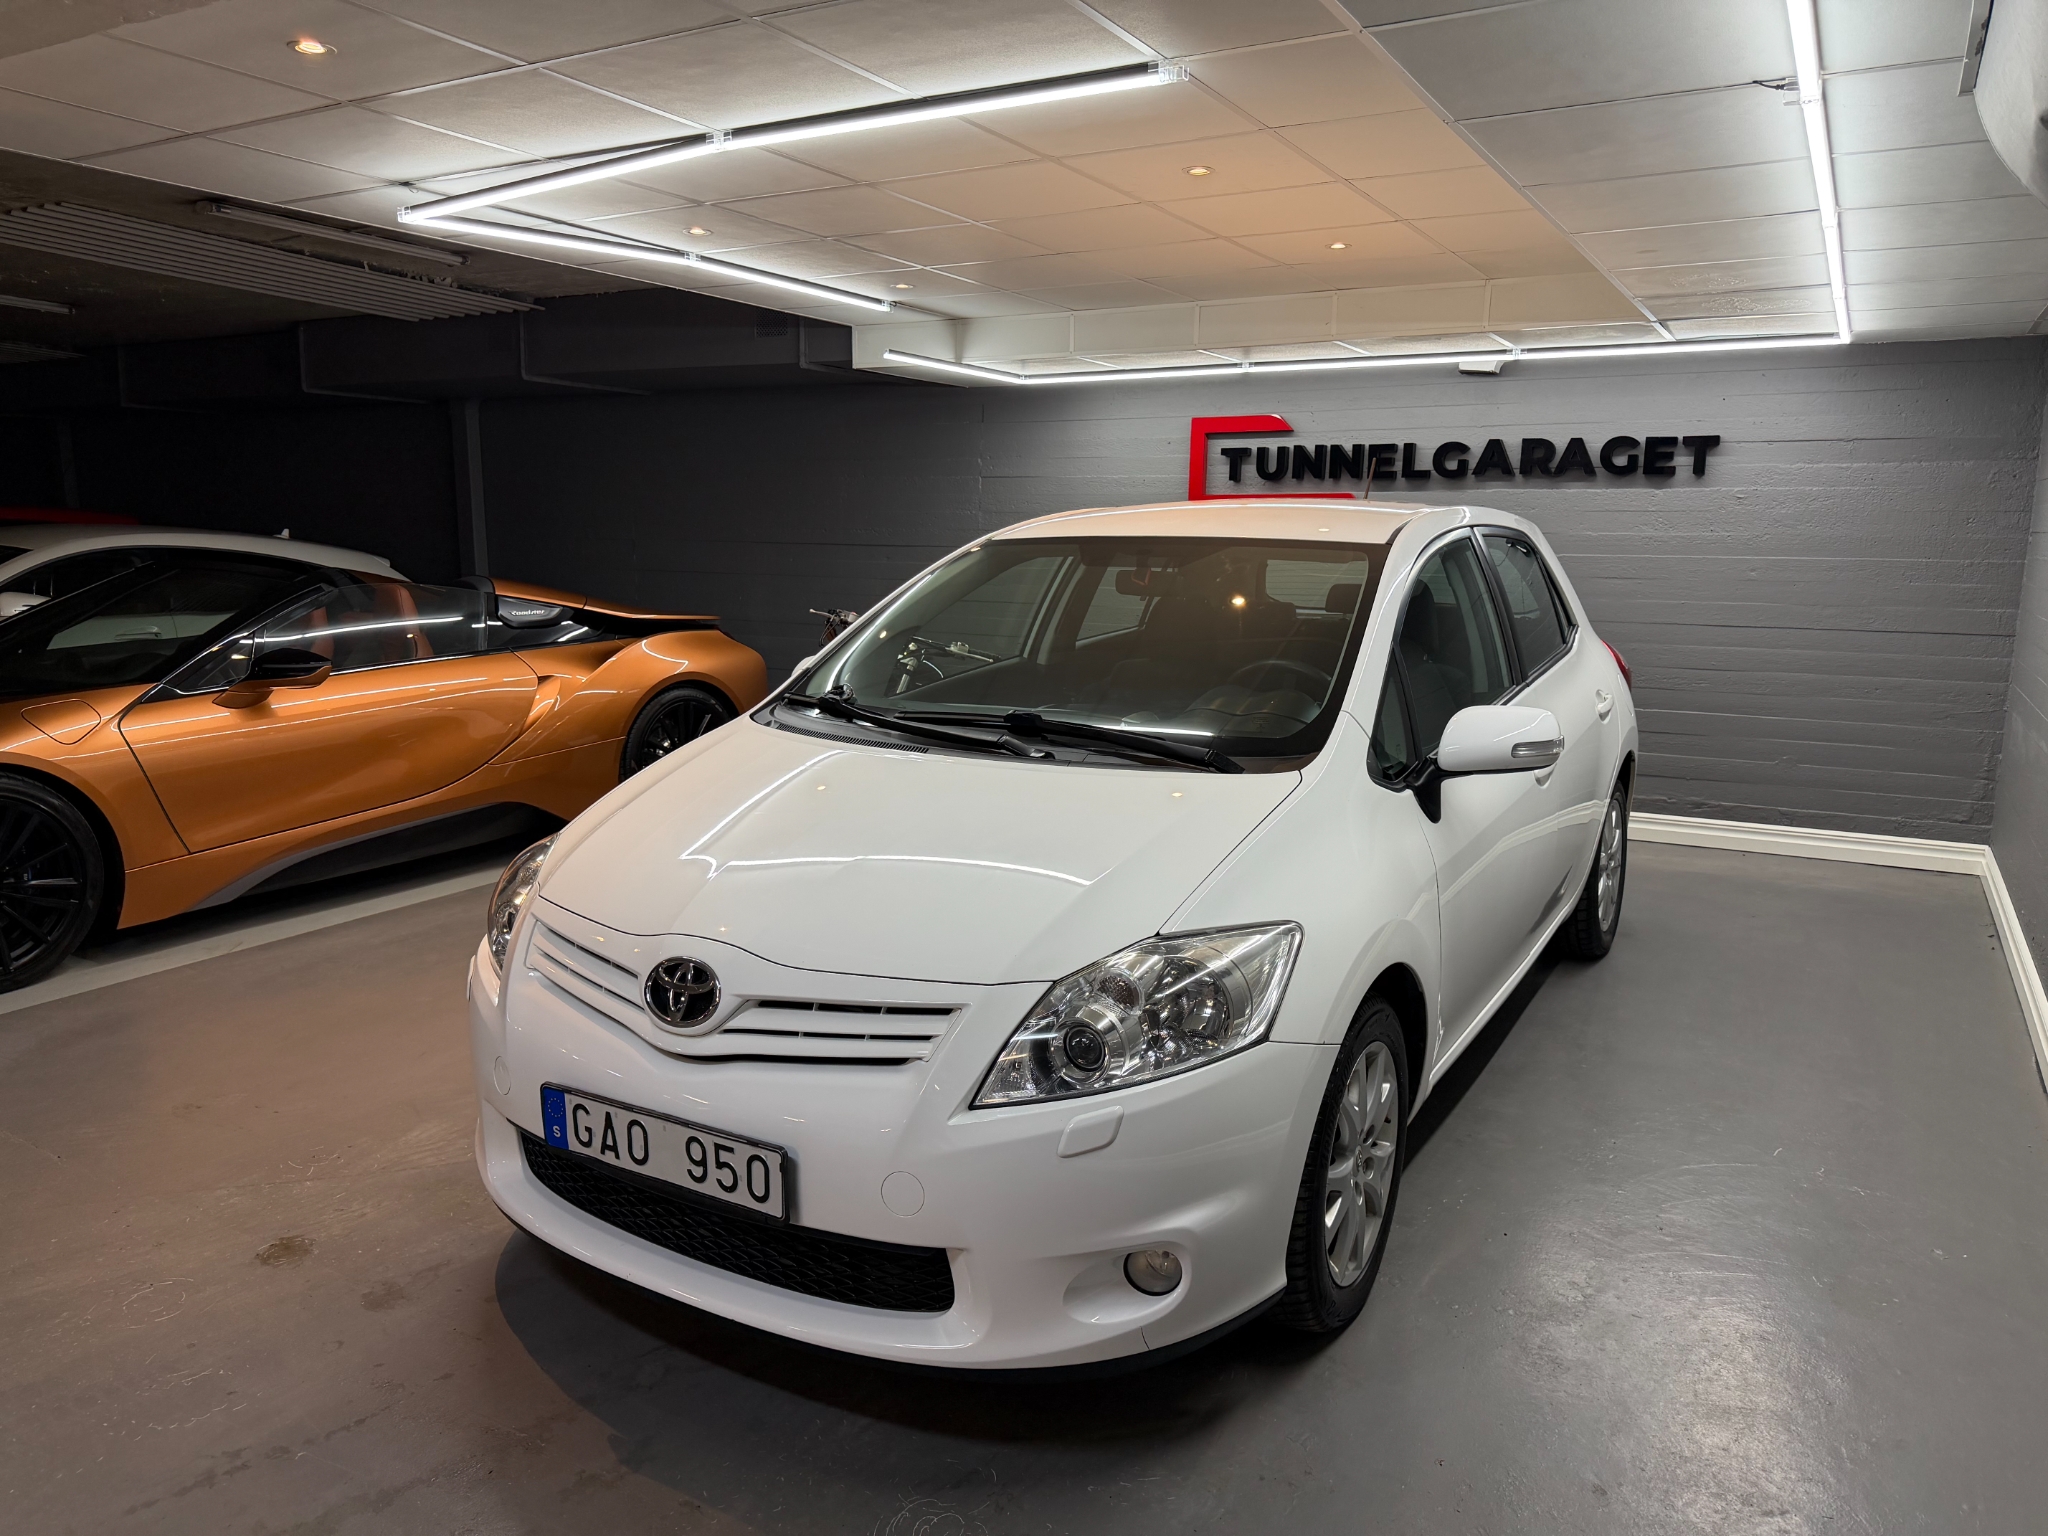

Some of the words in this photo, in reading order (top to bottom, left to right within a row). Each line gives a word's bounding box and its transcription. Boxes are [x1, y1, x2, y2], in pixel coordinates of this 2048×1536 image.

[1221, 435, 1720, 482] TUNNELGARAGET
[553, 1126, 561, 1138] S
[572, 1103, 649, 1166] GAO
[685, 1135, 770, 1204] 950
